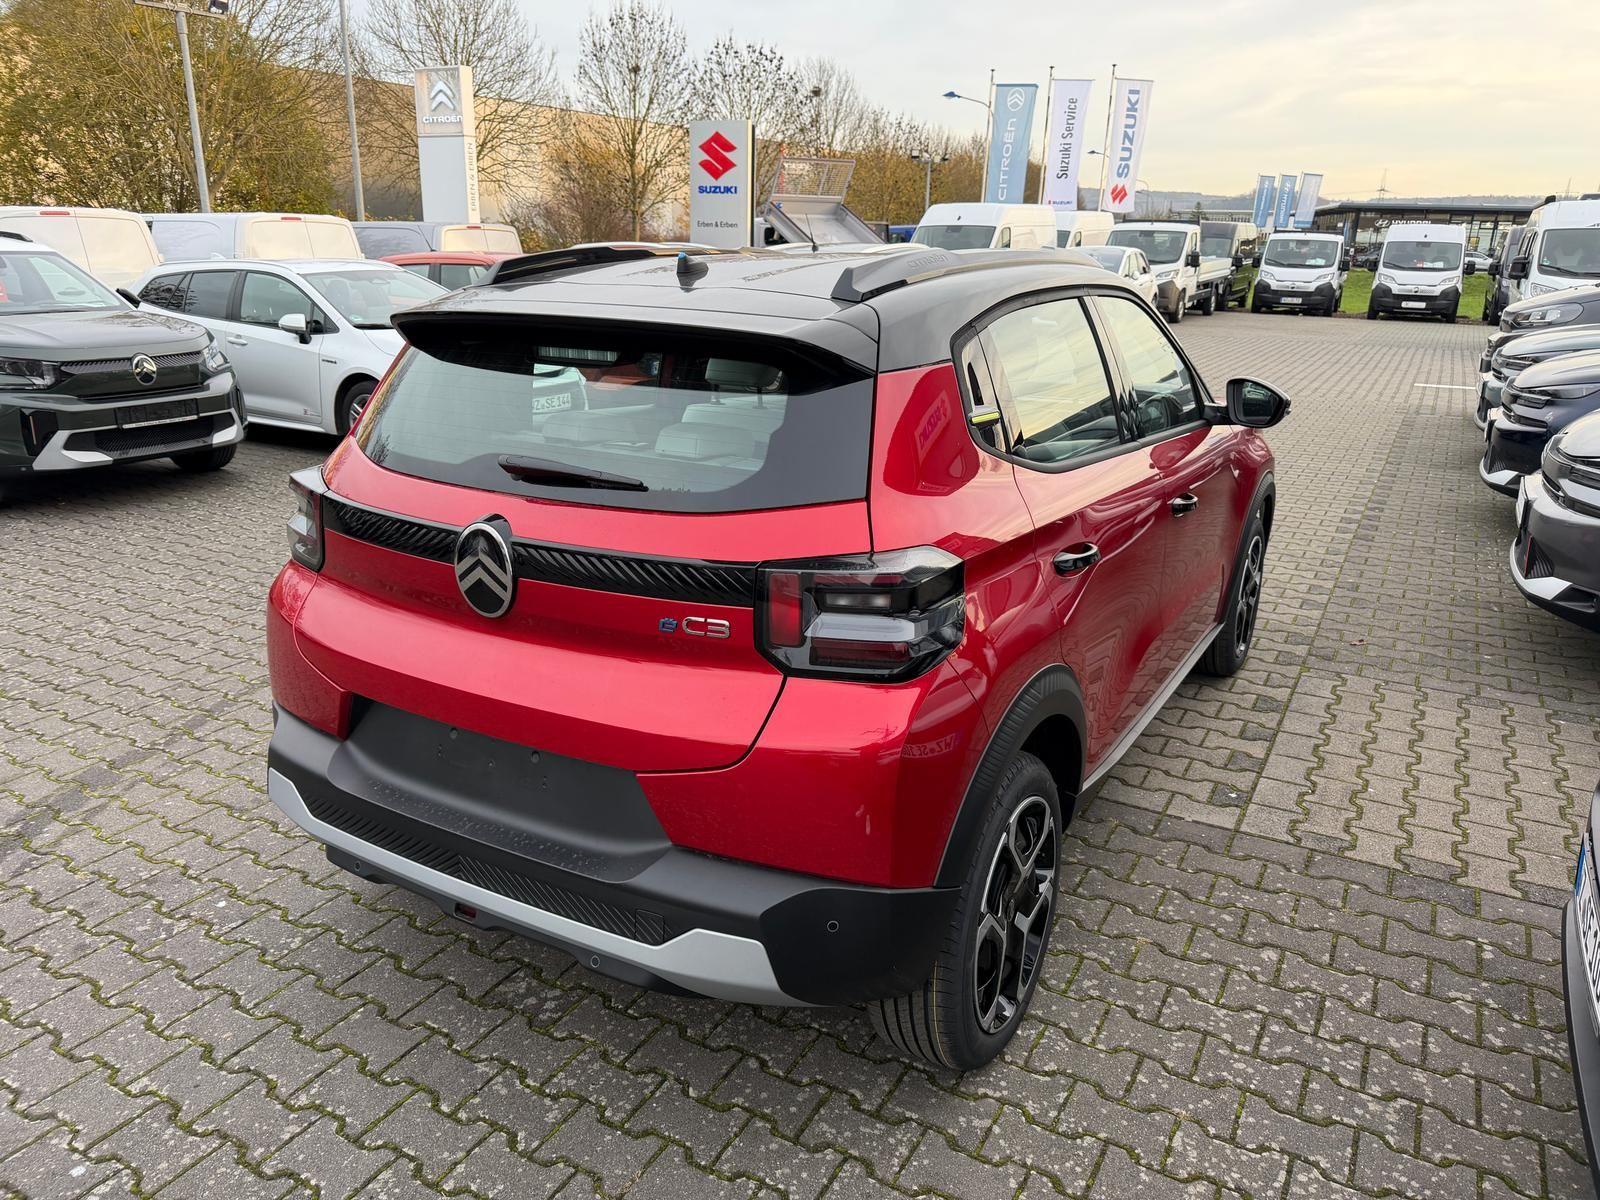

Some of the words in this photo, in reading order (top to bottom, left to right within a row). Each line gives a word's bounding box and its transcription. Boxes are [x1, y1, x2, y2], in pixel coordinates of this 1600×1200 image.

[1061, 97, 1078, 139] Service
[1116, 89, 1140, 178] SUZUKI
[1056, 143, 1072, 179] Suzuki
[698, 185, 738, 195] SUZUKI
[697, 220, 713, 228] Erben
[715, 220, 719, 228] &
[720, 221, 738, 229] Erben
